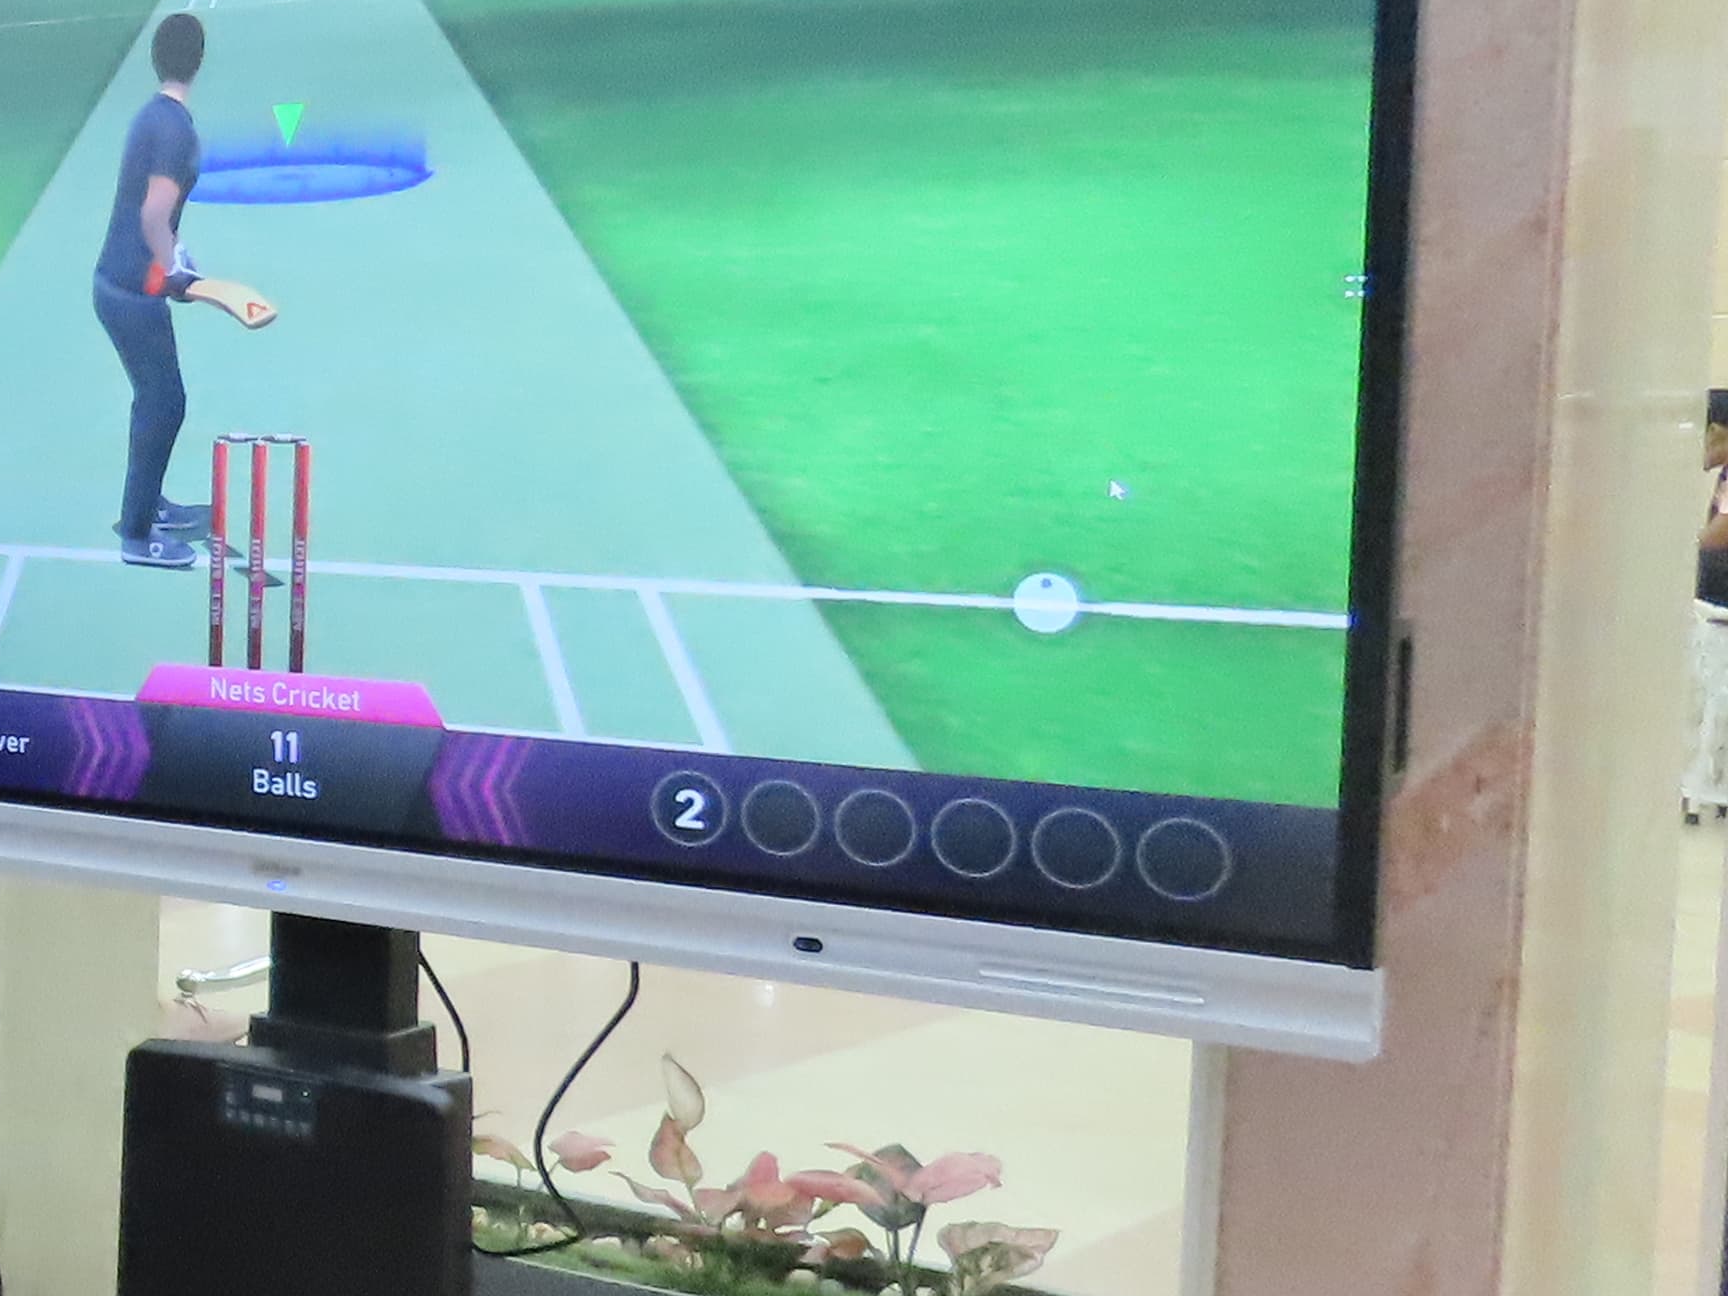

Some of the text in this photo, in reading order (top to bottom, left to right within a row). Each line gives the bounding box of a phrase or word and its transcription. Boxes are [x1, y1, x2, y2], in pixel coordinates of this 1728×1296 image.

[210, 676, 362, 713] Nets Cricket
[270, 730, 302, 764] 11
[251, 768, 319, 800] Balls
[672, 788, 706, 830] 2
